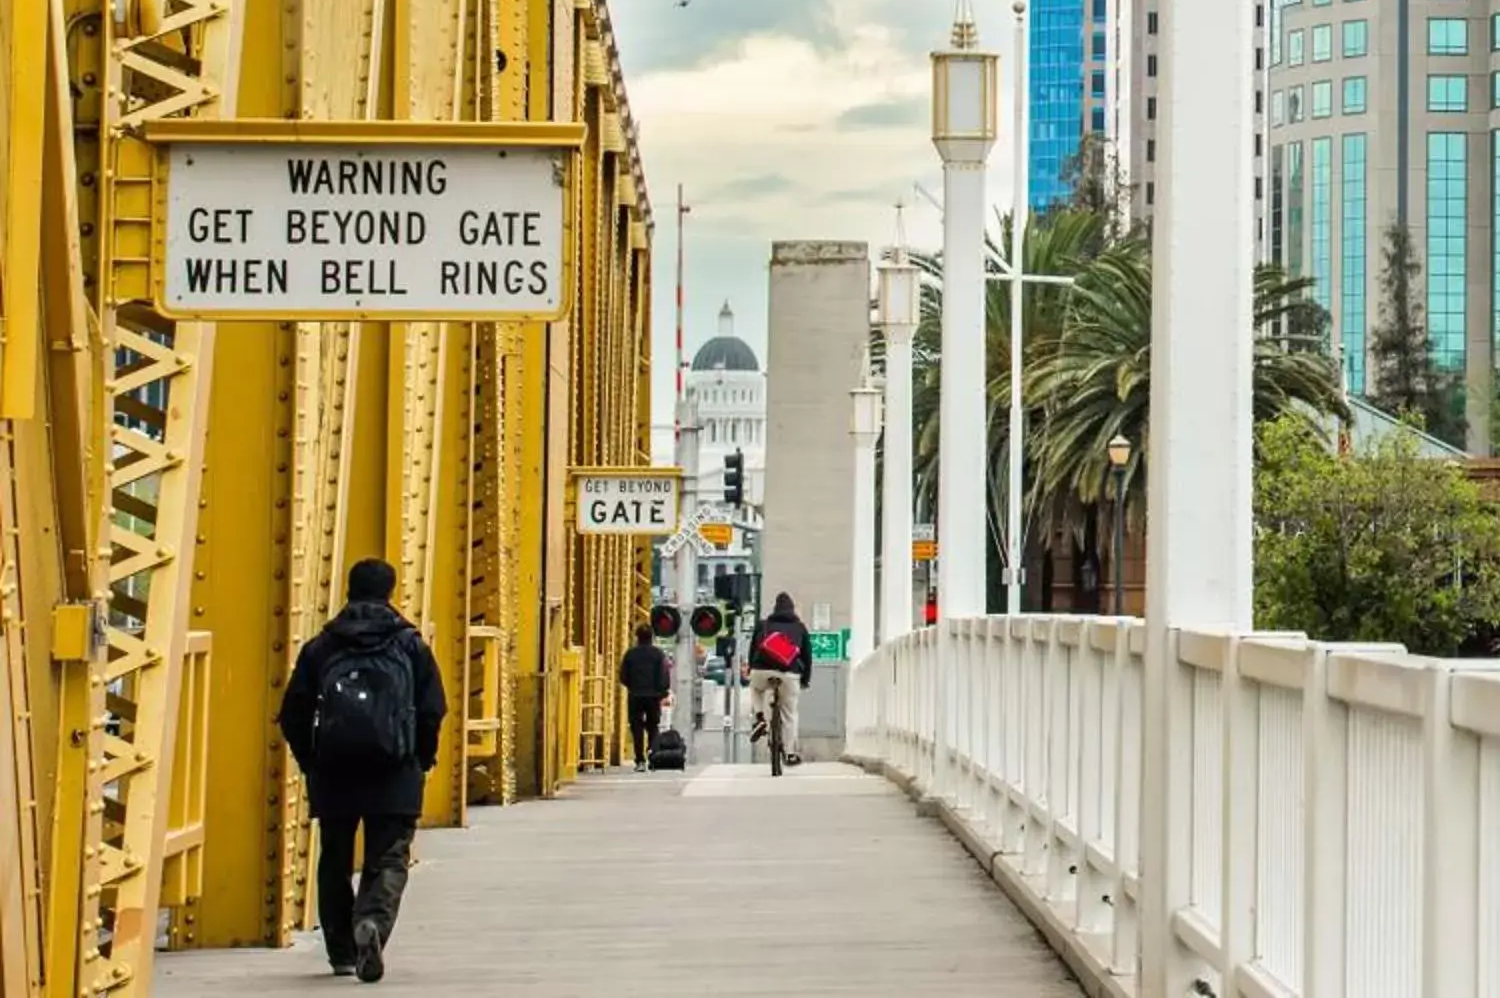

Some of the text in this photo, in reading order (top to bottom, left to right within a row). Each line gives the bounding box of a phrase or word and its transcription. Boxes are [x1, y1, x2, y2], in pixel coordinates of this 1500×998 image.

[287, 159, 447, 195] WARNING
[189, 208, 540, 246] GET BEYOND GATE
[186, 258, 546, 295] WHEN BELL RINGS
[585, 479, 671, 493] GET BEYOND
[591, 500, 664, 523] GATE
